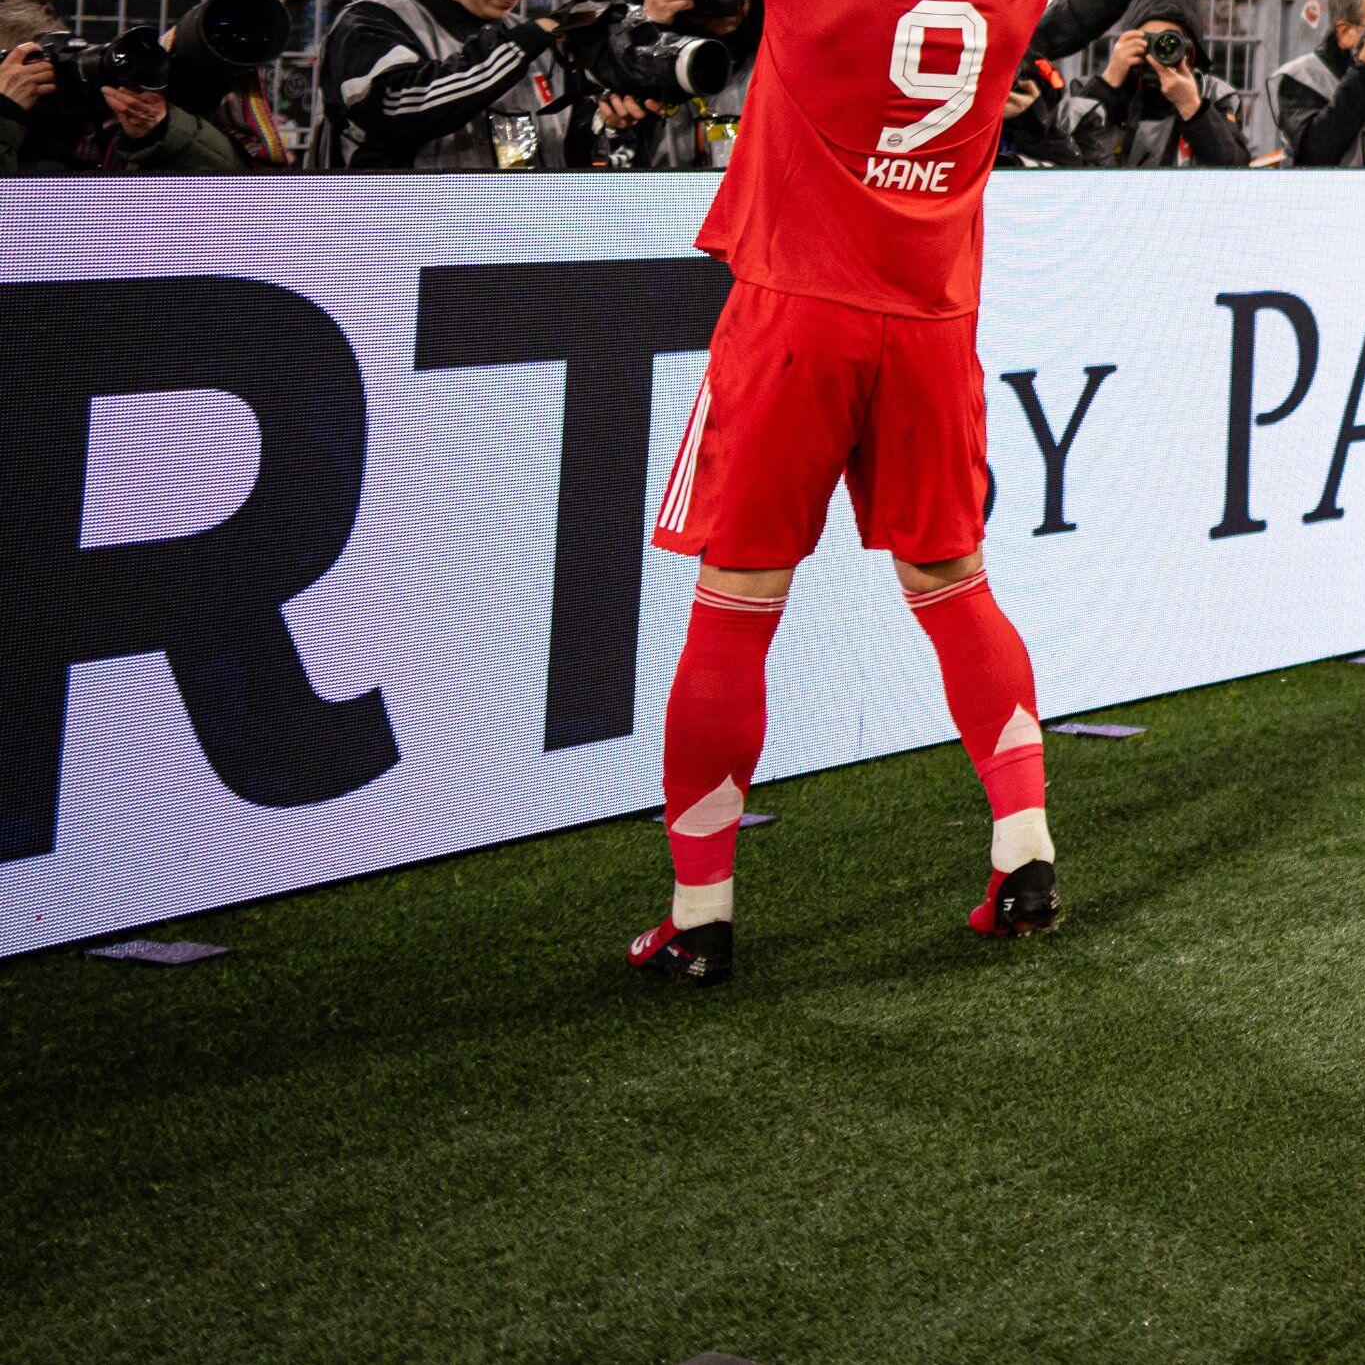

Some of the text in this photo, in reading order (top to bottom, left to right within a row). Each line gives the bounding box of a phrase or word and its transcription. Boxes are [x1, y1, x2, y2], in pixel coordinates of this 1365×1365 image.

[876, 0, 987, 153] 9
[862, 157, 956, 193] KANE
[0, 257, 732, 861] RT
